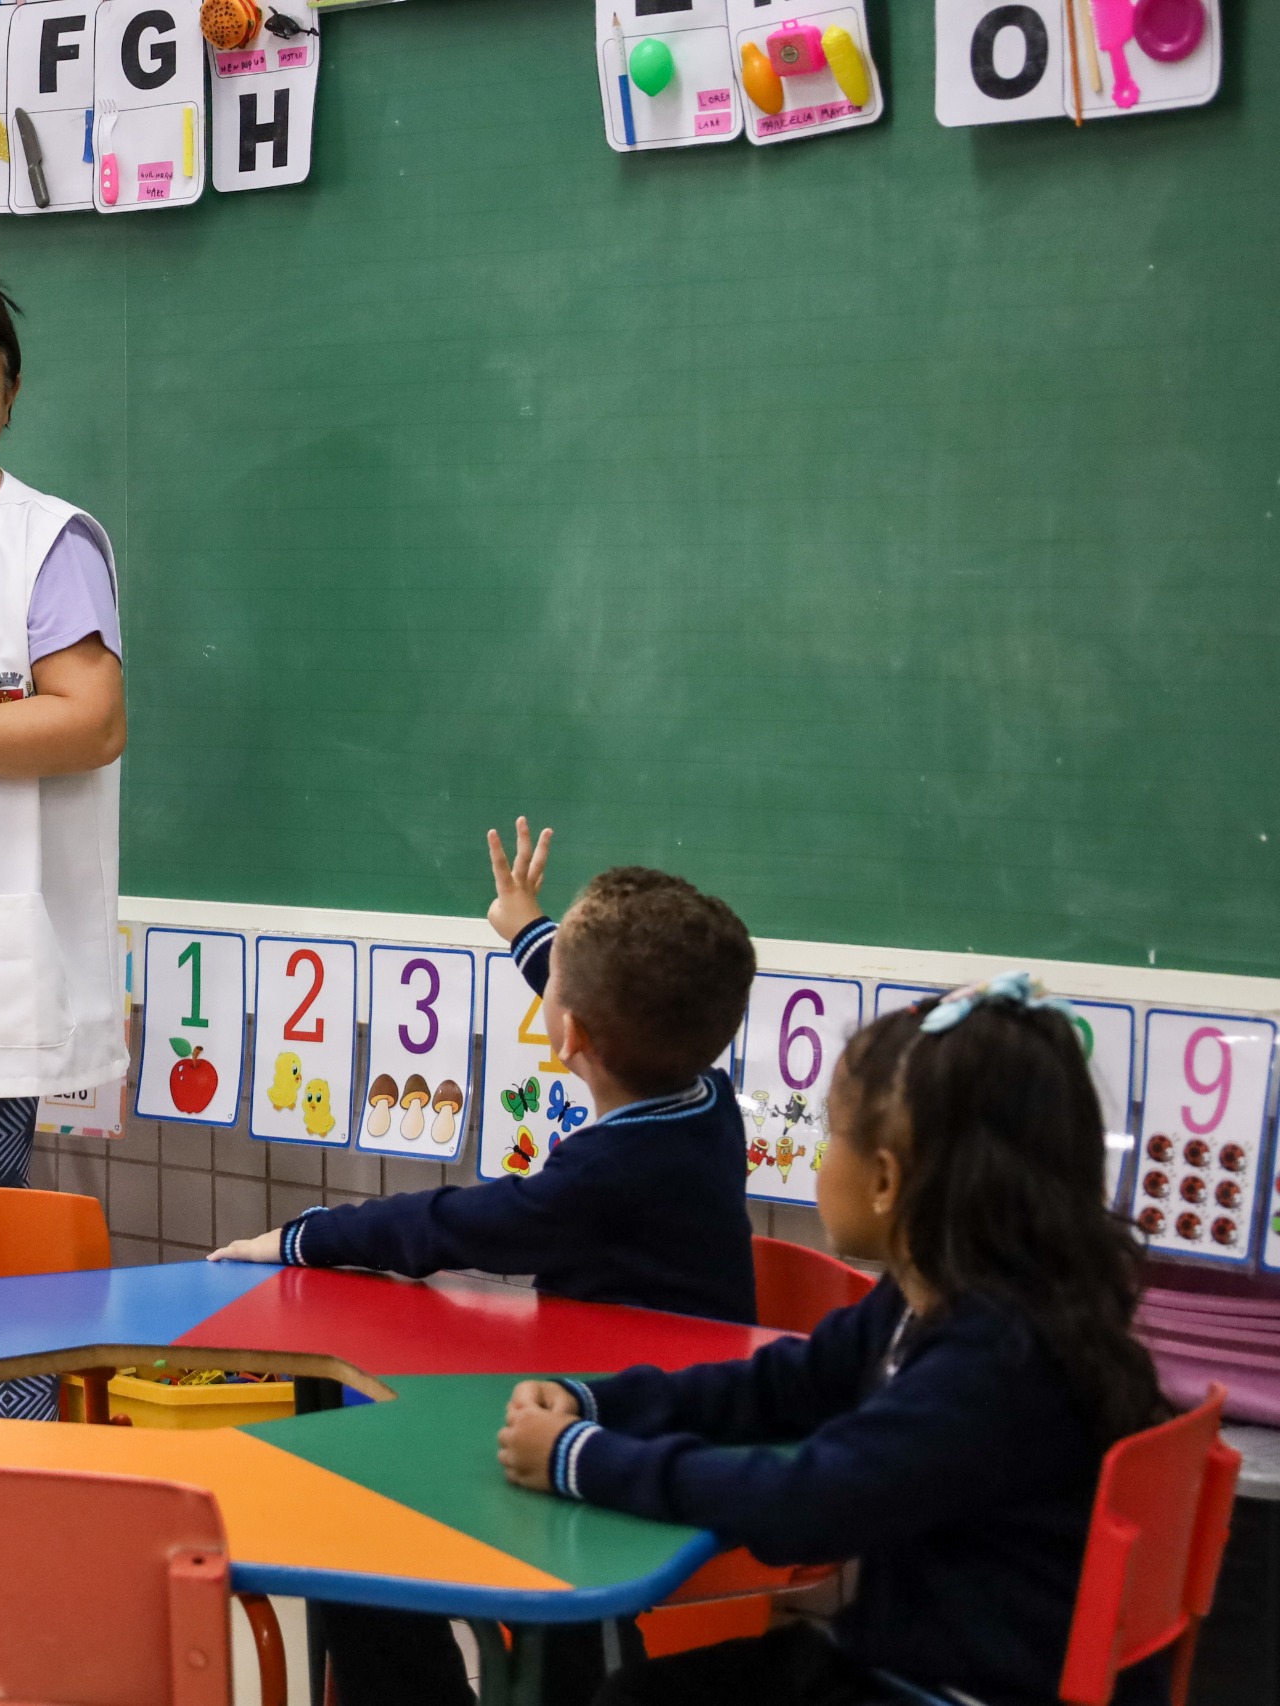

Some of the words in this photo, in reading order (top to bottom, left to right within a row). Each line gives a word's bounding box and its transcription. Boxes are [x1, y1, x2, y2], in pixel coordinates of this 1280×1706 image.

[39, 14, 86, 94] F
[121, 9, 176, 90] G
[970, 4, 1048, 100] O
[238, 87, 290, 172] H
[178, 941, 209, 1028] 1
[283, 948, 325, 1043] 2
[399, 958, 440, 1055] 3
[778, 988, 825, 1090] 6
[1181, 1026, 1232, 1134] 9
